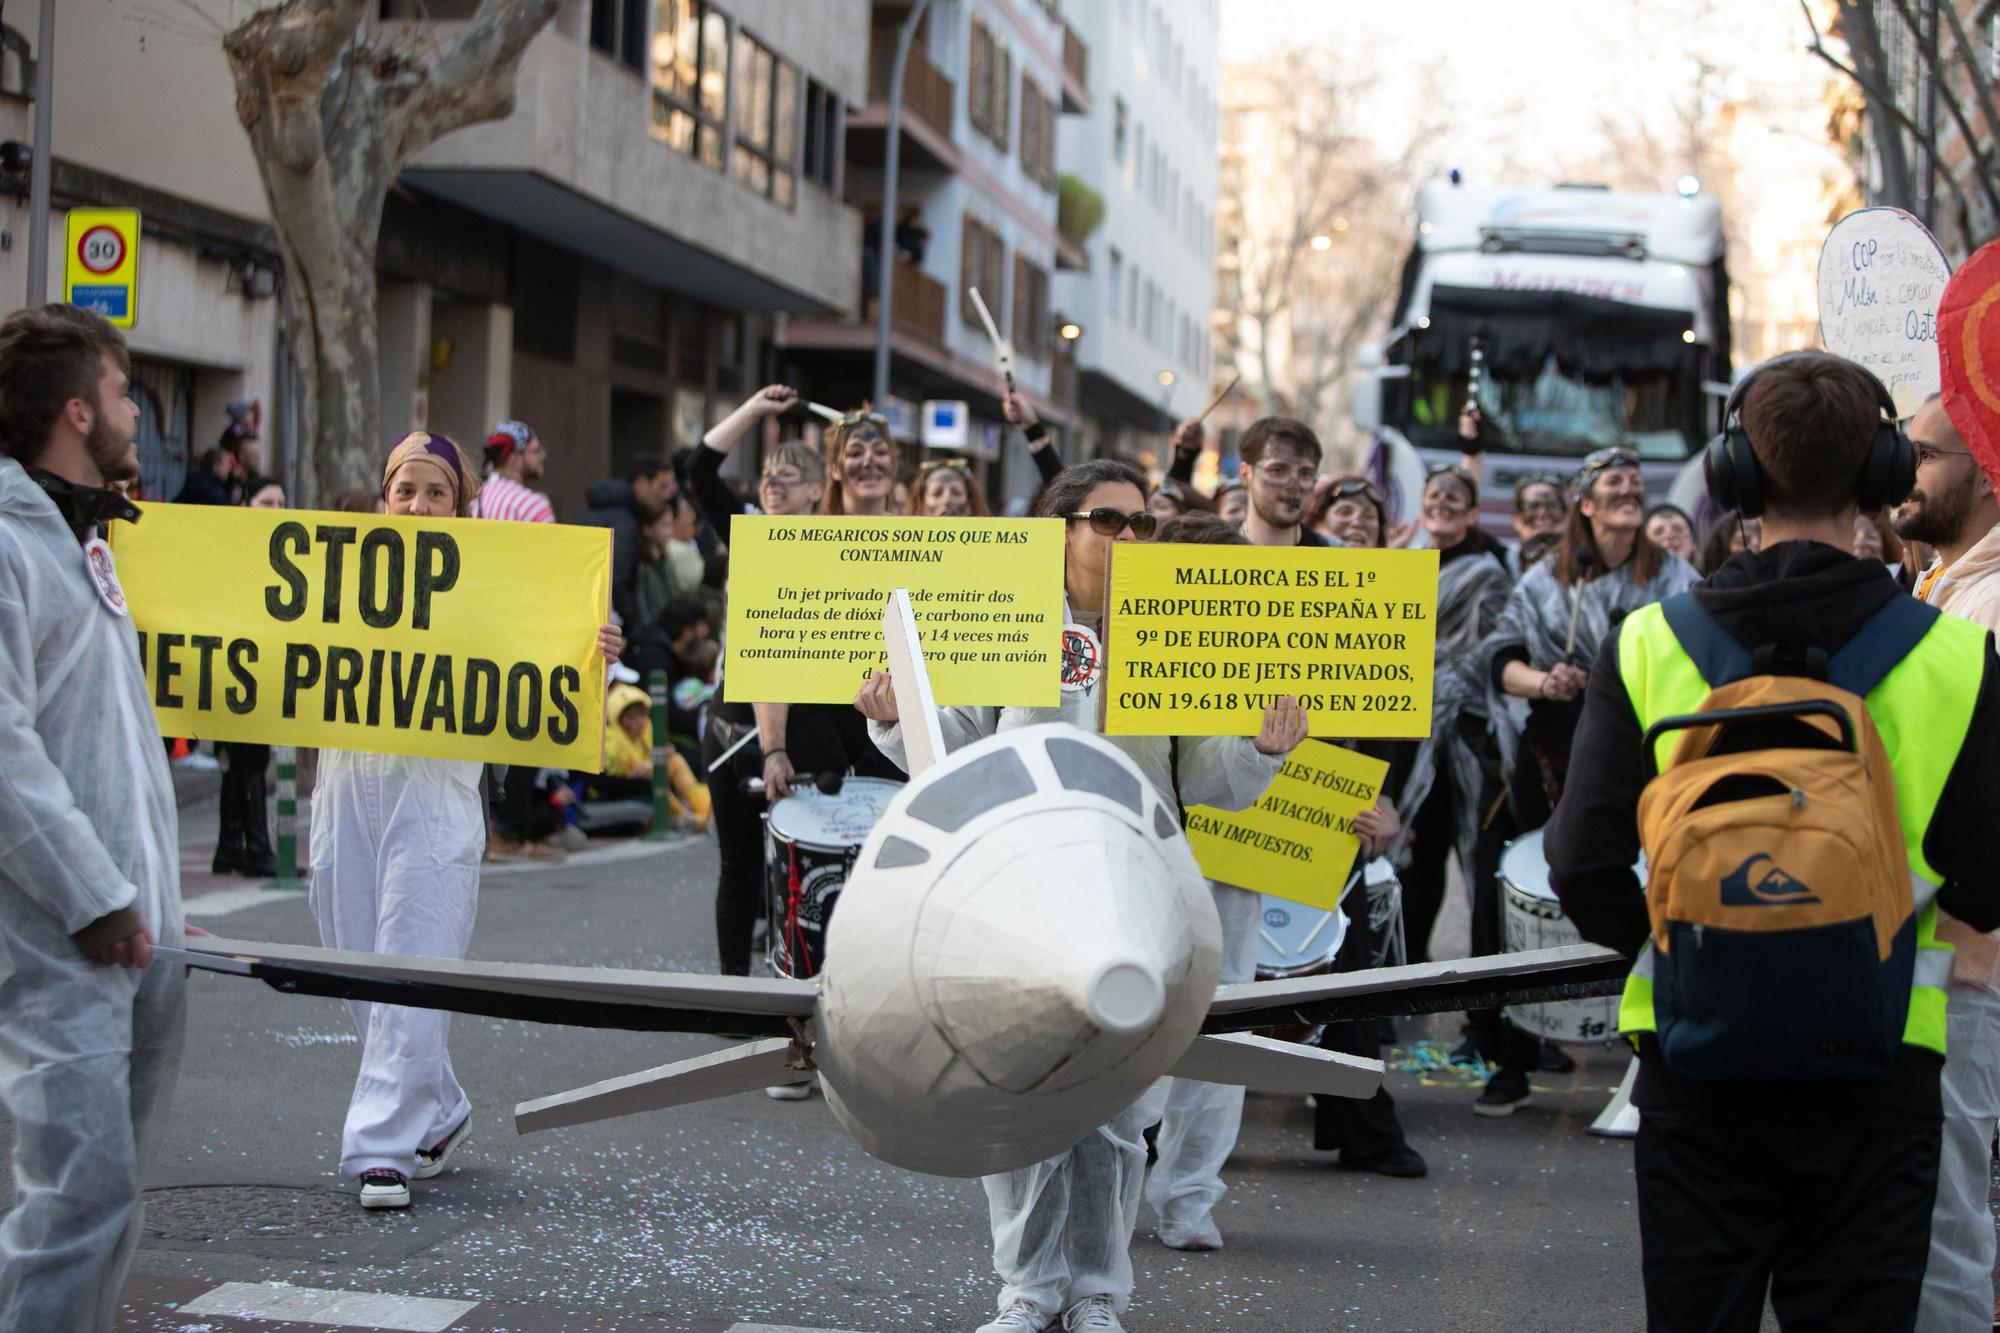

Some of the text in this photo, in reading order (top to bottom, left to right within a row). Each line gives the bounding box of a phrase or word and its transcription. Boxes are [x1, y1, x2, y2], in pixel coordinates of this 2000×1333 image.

[88, 241, 116, 260] 30
[1852, 238, 1878, 272] COP
[768, 528, 1029, 545] LOS MEGARICOS SON LOS QUE MAS
[840, 548, 944, 563] CONTAMINAN
[264, 521, 461, 630] STOP
[1175, 567, 1376, 588] MALLORCA ES EL 1º
[777, 588, 797, 600] Un
[800, 588, 822, 603] jet
[824, 588, 883, 604] privado
[937, 590, 985, 603] emitir
[983, 590, 1015, 603] dos
[745, 607, 820, 620] toneladas
[823, 608, 842, 620] de
[845, 608, 886, 621] dióxi
[926, 610, 989, 623] carbono
[993, 614, 1011, 623] en
[1015, 614, 1045, 624] una
[1118, 598, 1426, 619] AEROPUERTO DE ESPAÑA Y EL
[759, 627, 795, 639] hora
[799, 629, 808, 643] y
[811, 630, 827, 640] es
[830, 629, 871, 641] entre
[931, 629, 949, 641] 14
[953, 632, 993, 642] veces
[997, 629, 1030, 643] más
[1136, 630, 1407, 650] 9º DE EUROPA CON MAYOR
[740, 647, 845, 660] contaminante
[848, 650, 876, 663] por
[949, 653, 979, 664] que
[981, 652, 1001, 662] un
[1005, 650, 1048, 663] avión
[1125, 661, 1414, 684] TRAFICO DE JETS PRIVADOS,
[281, 642, 581, 746] PRIVADOS
[1119, 692, 1162, 710] CON
[1169, 692, 1238, 710] 19.618
[1329, 694, 1356, 711] EN
[1362, 694, 1417, 712] 2022.
[1312, 769, 1376, 801] FÓSILES
[1262, 795, 1337, 829] AVIACIÓN
[1222, 823, 1314, 862] IMPUESTOS.
